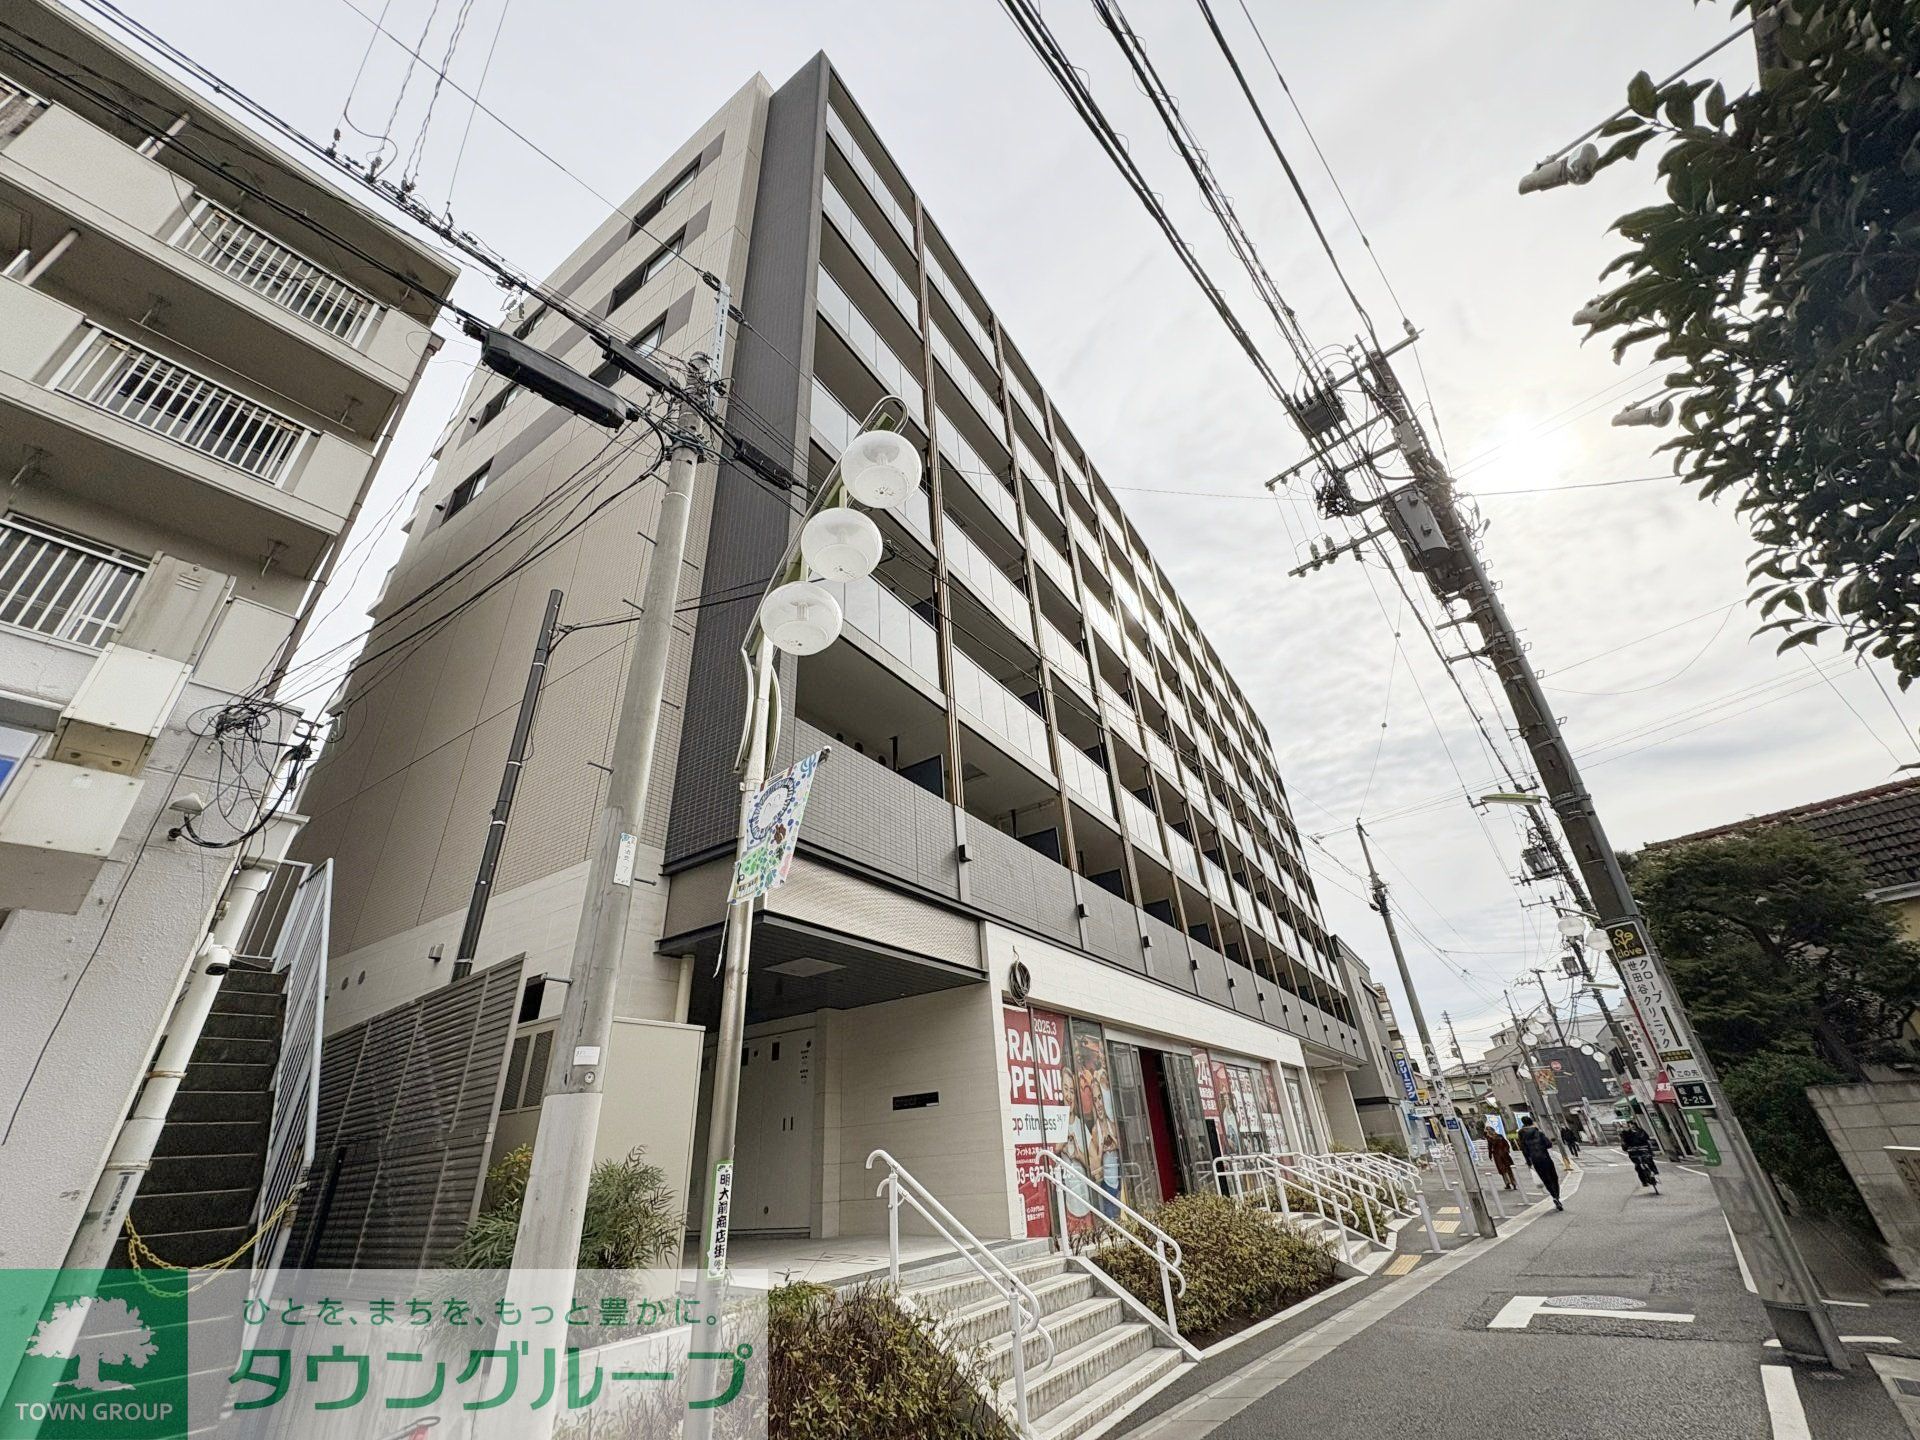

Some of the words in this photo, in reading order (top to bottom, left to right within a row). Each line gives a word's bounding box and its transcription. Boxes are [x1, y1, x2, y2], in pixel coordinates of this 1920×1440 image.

[1617, 947, 1643, 959] clove
[1640, 959, 1662, 1004] クローブ
[1627, 961, 1670, 1049] 世田谷クリニック
[1033, 1018, 1057, 1036] 2025.3
[1006, 1028, 1061, 1066] RAND
[1010, 1065, 1064, 1101] PEN!!
[1676, 1069, 1699, 1078] この先
[1682, 1095, 1706, 1105] 2-25
[1025, 1113, 1057, 1131] fitness
[714, 1173, 731, 1259] 明大前商店街
